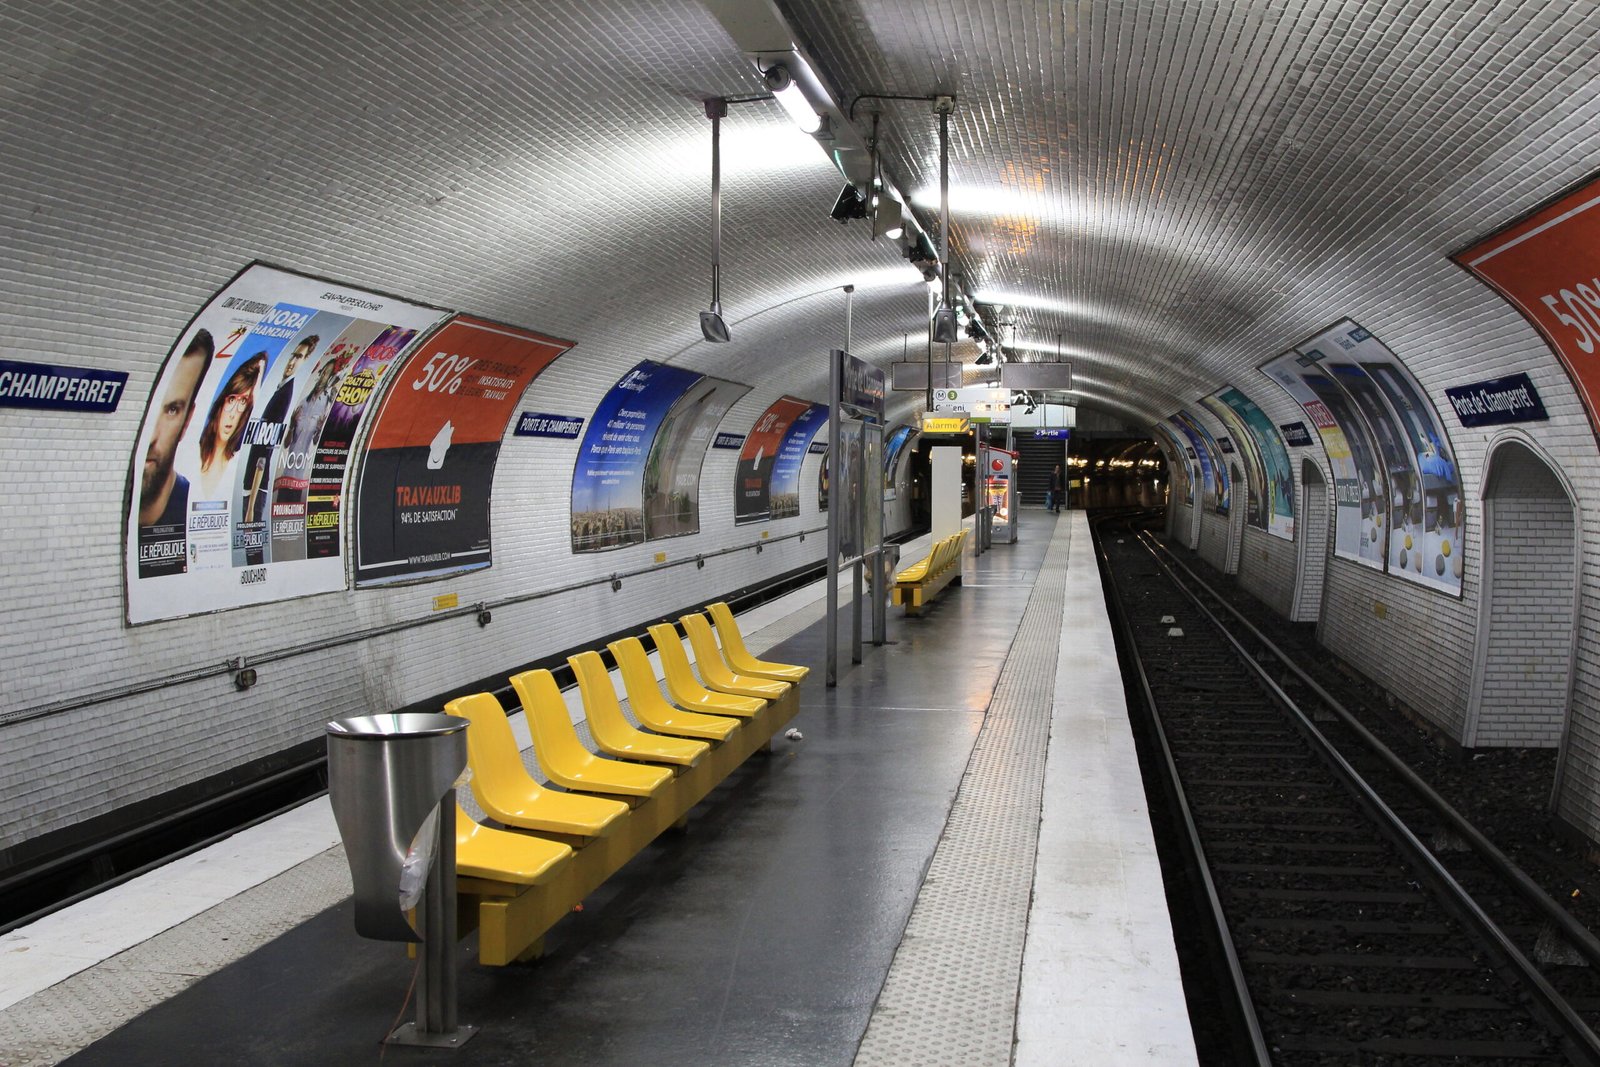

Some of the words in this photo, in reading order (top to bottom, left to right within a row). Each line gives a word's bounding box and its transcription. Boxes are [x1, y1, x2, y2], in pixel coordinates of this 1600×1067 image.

[262, 308, 309, 329] NORA
[412, 352, 479, 395] 50%
[0, 371, 122, 403] CHAMPERRET
[336, 386, 372, 404] SHOW
[1450, 390, 1477, 415] Porte
[1470, 391, 1487, 413] de
[1480, 384, 1534, 415] Champerret
[243, 421, 287, 446] HAROUN
[520, 417, 540, 431] PORTE
[538, 419, 549, 432] DE
[547, 420, 582, 434] CHAMPERRET
[278, 451, 312, 470] NOOM
[396, 485, 462, 507] TRAVAUXLIB
[189, 517, 197, 529] LE
[307, 515, 314, 526] LE
[401, 512, 413, 524] 94%
[413, 511, 421, 523] DE
[273, 523, 280, 533] LE
[140, 545, 149, 558] LE
